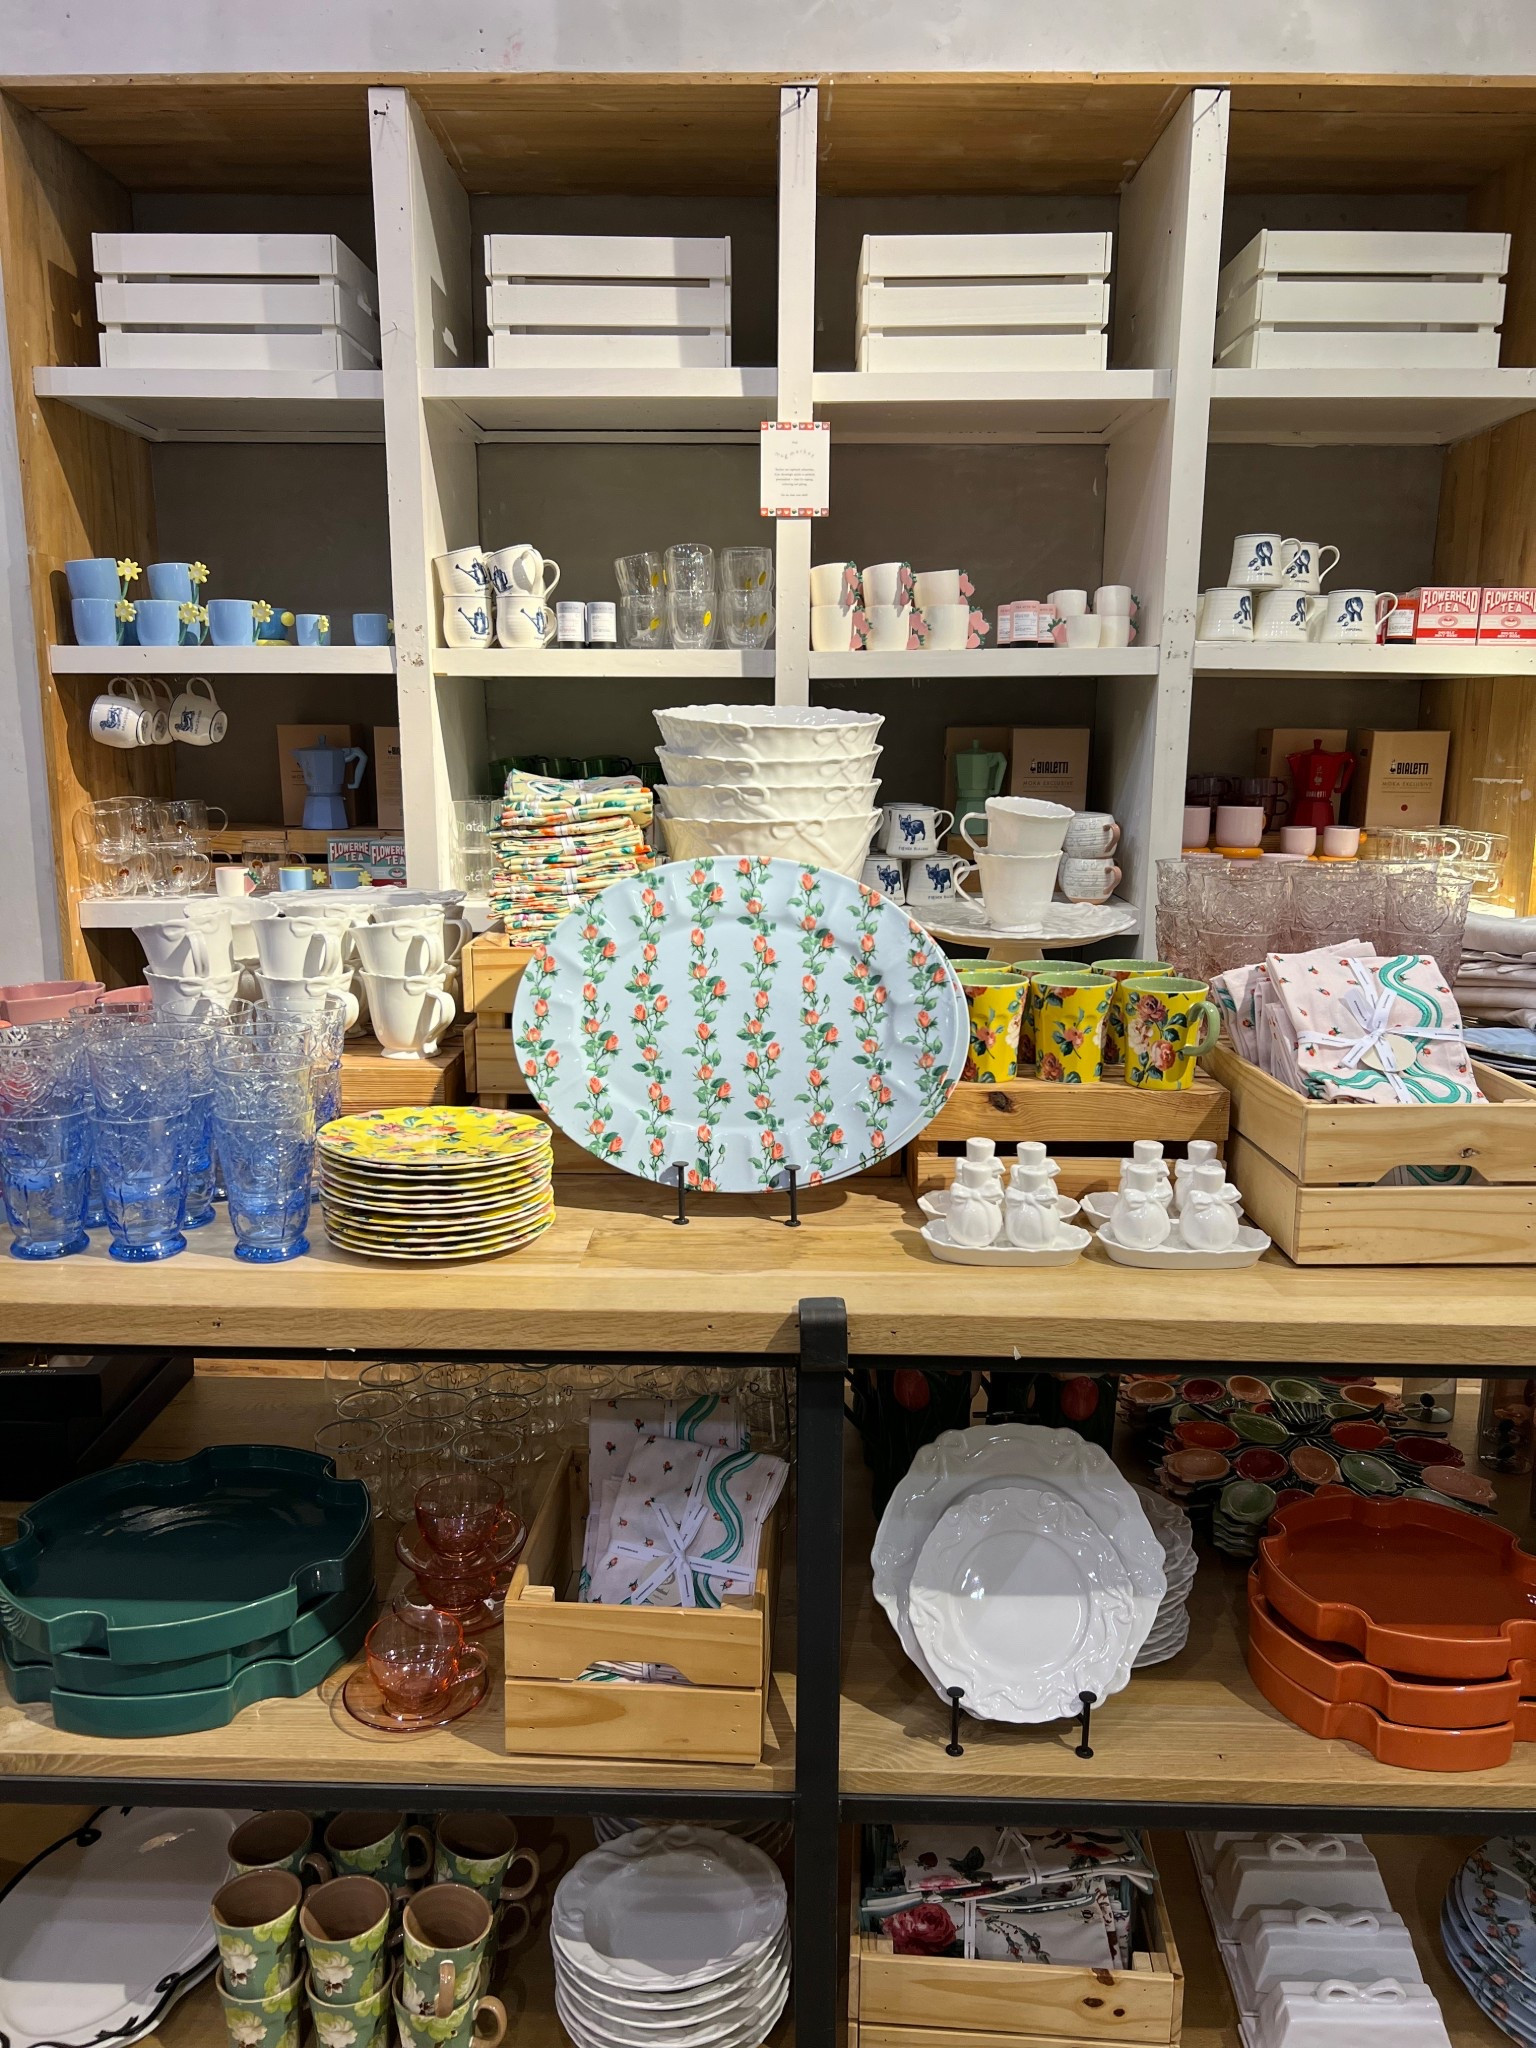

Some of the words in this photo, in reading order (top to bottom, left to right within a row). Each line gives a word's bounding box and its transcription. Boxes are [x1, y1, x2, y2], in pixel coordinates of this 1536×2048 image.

[1421, 590, 1478, 613] FLOWERHEAD
[1437, 602, 1460, 613] TEA
[1500, 602, 1522, 613] TEA
[1037, 762, 1068, 774] BIALETTI
[1397, 762, 1429, 775] BIALETTI
[329, 842, 370, 862] FLOWERHE
[344, 852, 364, 861] TEA
[385, 855, 406, 865] TEA
